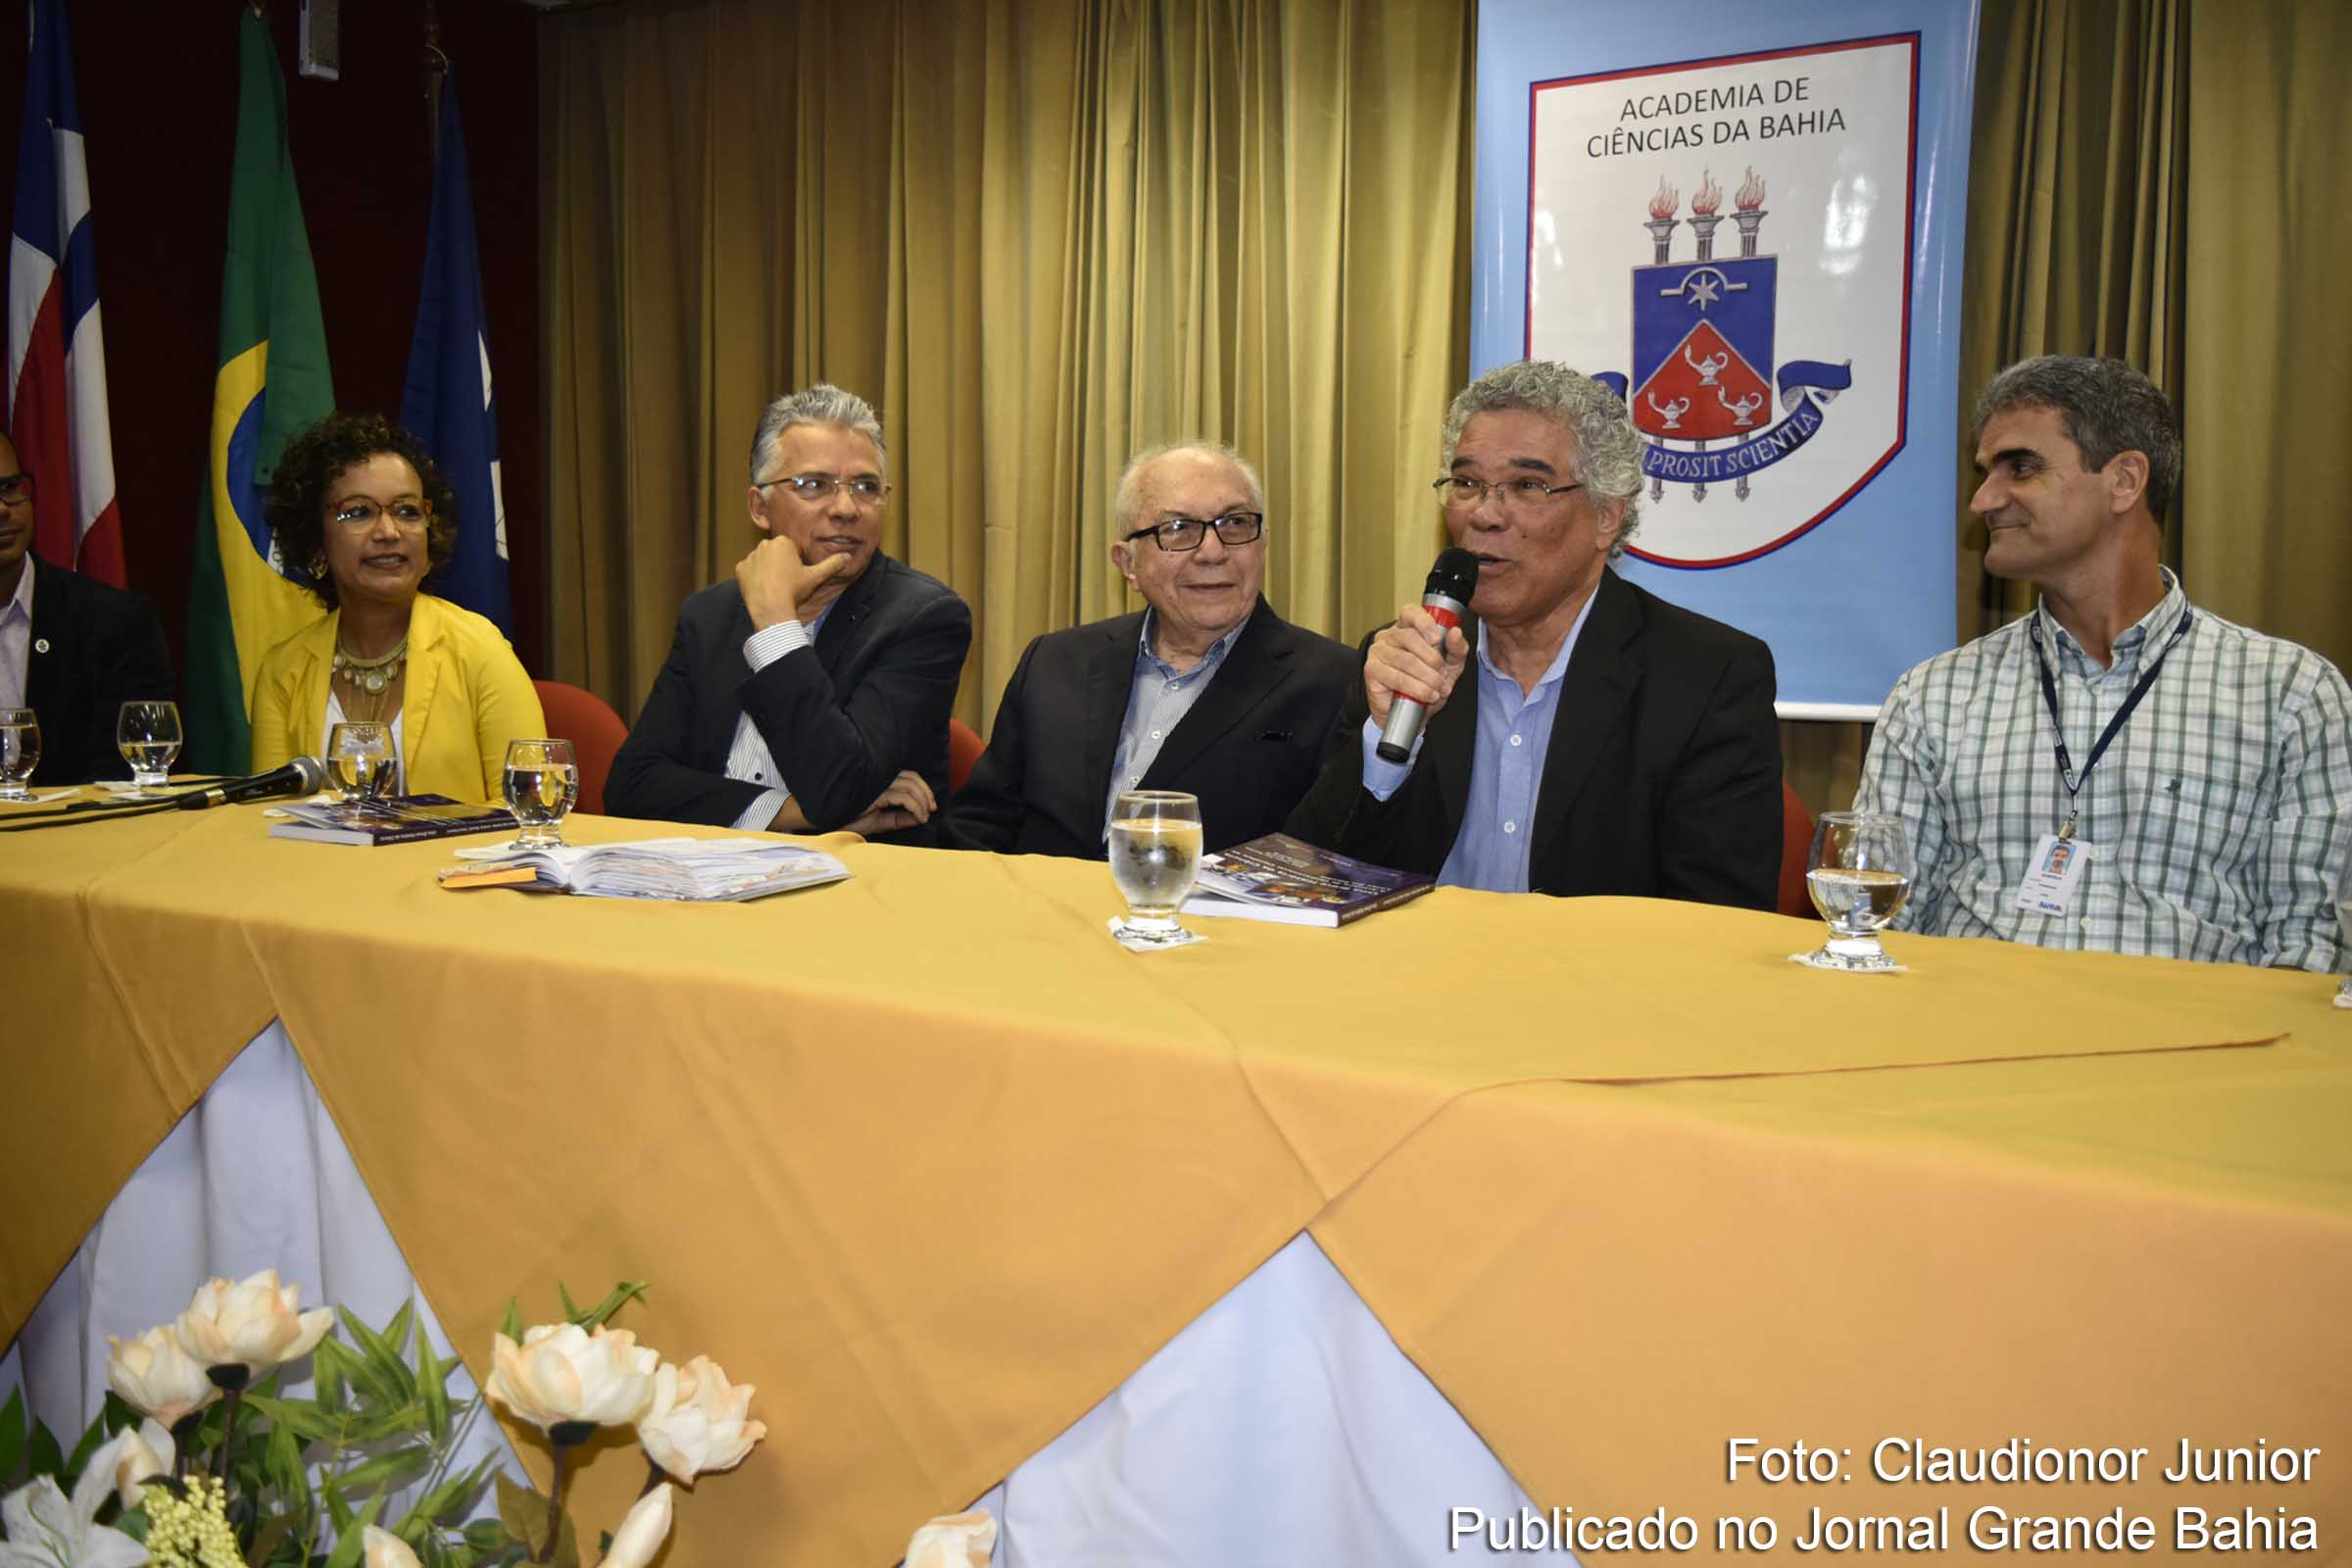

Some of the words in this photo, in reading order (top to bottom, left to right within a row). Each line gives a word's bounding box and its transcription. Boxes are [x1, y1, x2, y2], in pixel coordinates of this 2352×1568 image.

[1620, 82, 1764, 122] ACADEMIA
[1775, 77, 1810, 103] DE
[1588, 123, 1703, 158] CIÊNCIAS
[1714, 120, 1750, 144] DA
[1760, 108, 1846, 139] BAHIA
[1646, 451, 1721, 477] PROSIT
[1726, 413, 1818, 473] SCIENTIA
